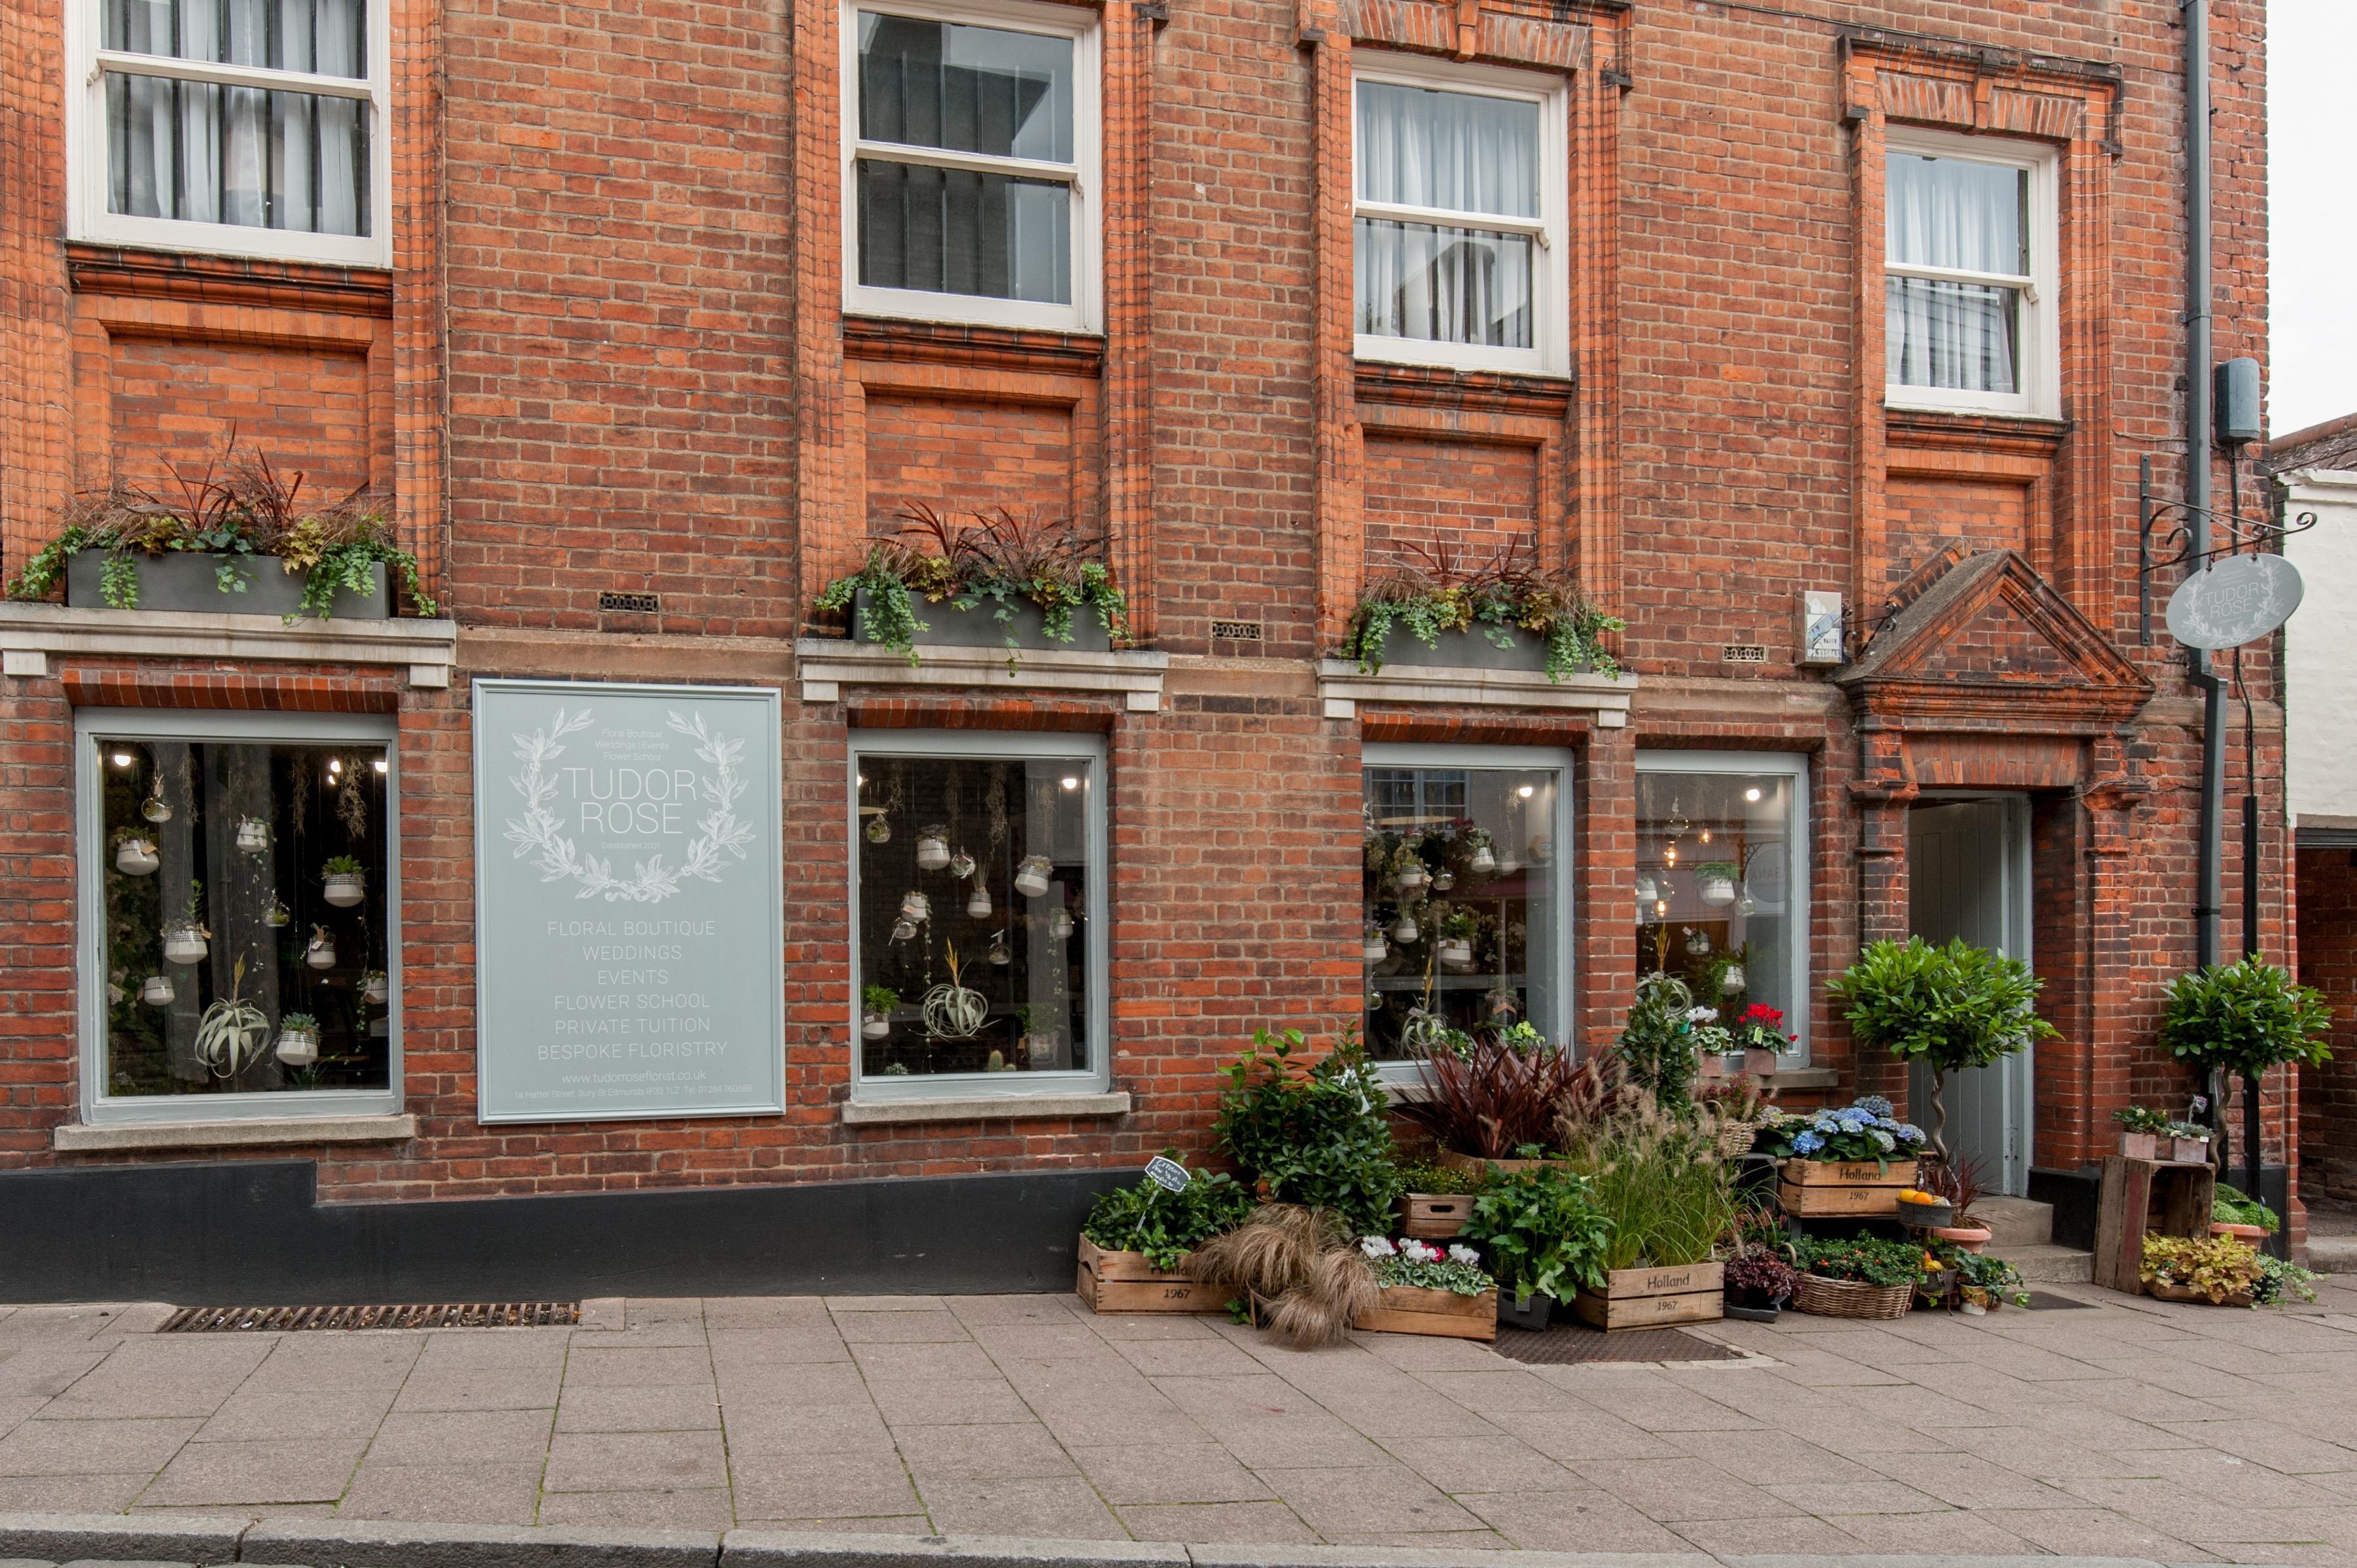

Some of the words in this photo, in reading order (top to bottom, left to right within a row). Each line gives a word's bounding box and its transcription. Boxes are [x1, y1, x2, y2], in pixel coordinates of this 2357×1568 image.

[2204, 582, 2259, 605] TUDOR
[2210, 597, 2252, 619] ROSE
[601, 728, 624, 737] Floral
[627, 729, 663, 739] Boutique
[595, 740, 635, 750] Weddings
[642, 741, 669, 750] Events
[603, 752, 631, 760] Flower
[633, 752, 662, 761] School
[562, 767, 697, 801] TUDOR
[581, 802, 683, 834] ROSE
[548, 921, 617, 936] FLORAL
[624, 920, 715, 937] BOUTIQUE
[582, 945, 682, 960] WEDDINGS
[597, 969, 669, 984] EVENTS
[555, 994, 629, 1010] FLOWER
[637, 993, 710, 1009] SCHOOL
[556, 1019, 631, 1034] PRIVATE
[637, 1017, 710, 1033] TUITION
[538, 1043, 622, 1060] BESPOKE
[629, 1041, 728, 1058] FLORISTRY
[561, 1070, 706, 1084] www.tudorroseflorist.co.uk
[525, 1090, 550, 1099] Hatter
[578, 1089, 596, 1098] Bury
[597, 1088, 606, 1097] St
[607, 1087, 645, 1096] Edmunds
[698, 1085, 722, 1094] 01284
[1839, 1167, 1881, 1180] Holland
[1849, 1191, 1870, 1201] 1967
[1647, 1272, 1690, 1289] Holland
[1163, 1289, 1191, 1299] 1967
[1657, 1300, 1678, 1311] 1967
